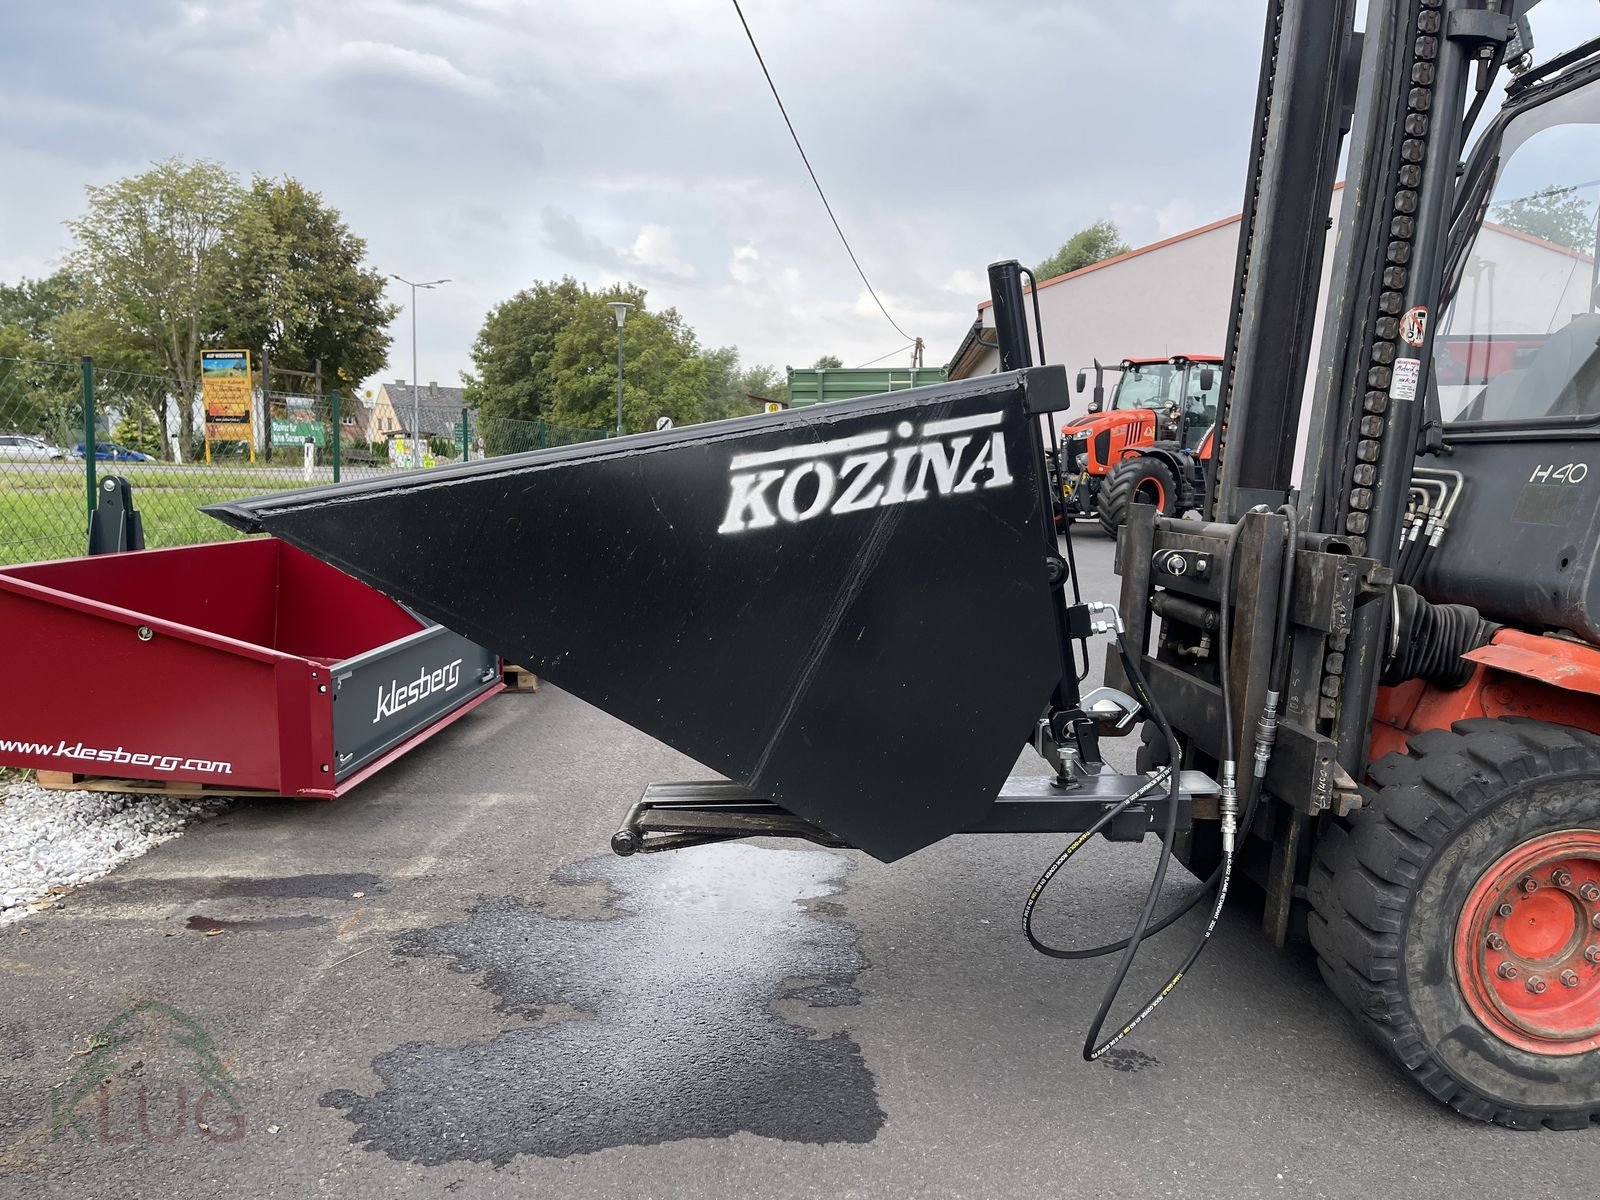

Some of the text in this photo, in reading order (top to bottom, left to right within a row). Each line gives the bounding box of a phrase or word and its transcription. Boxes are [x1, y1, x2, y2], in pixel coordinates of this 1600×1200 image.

[1529, 463, 1588, 483] H40
[373, 659, 462, 723] klesberg
[0, 740, 232, 773] www.klesberg.com
